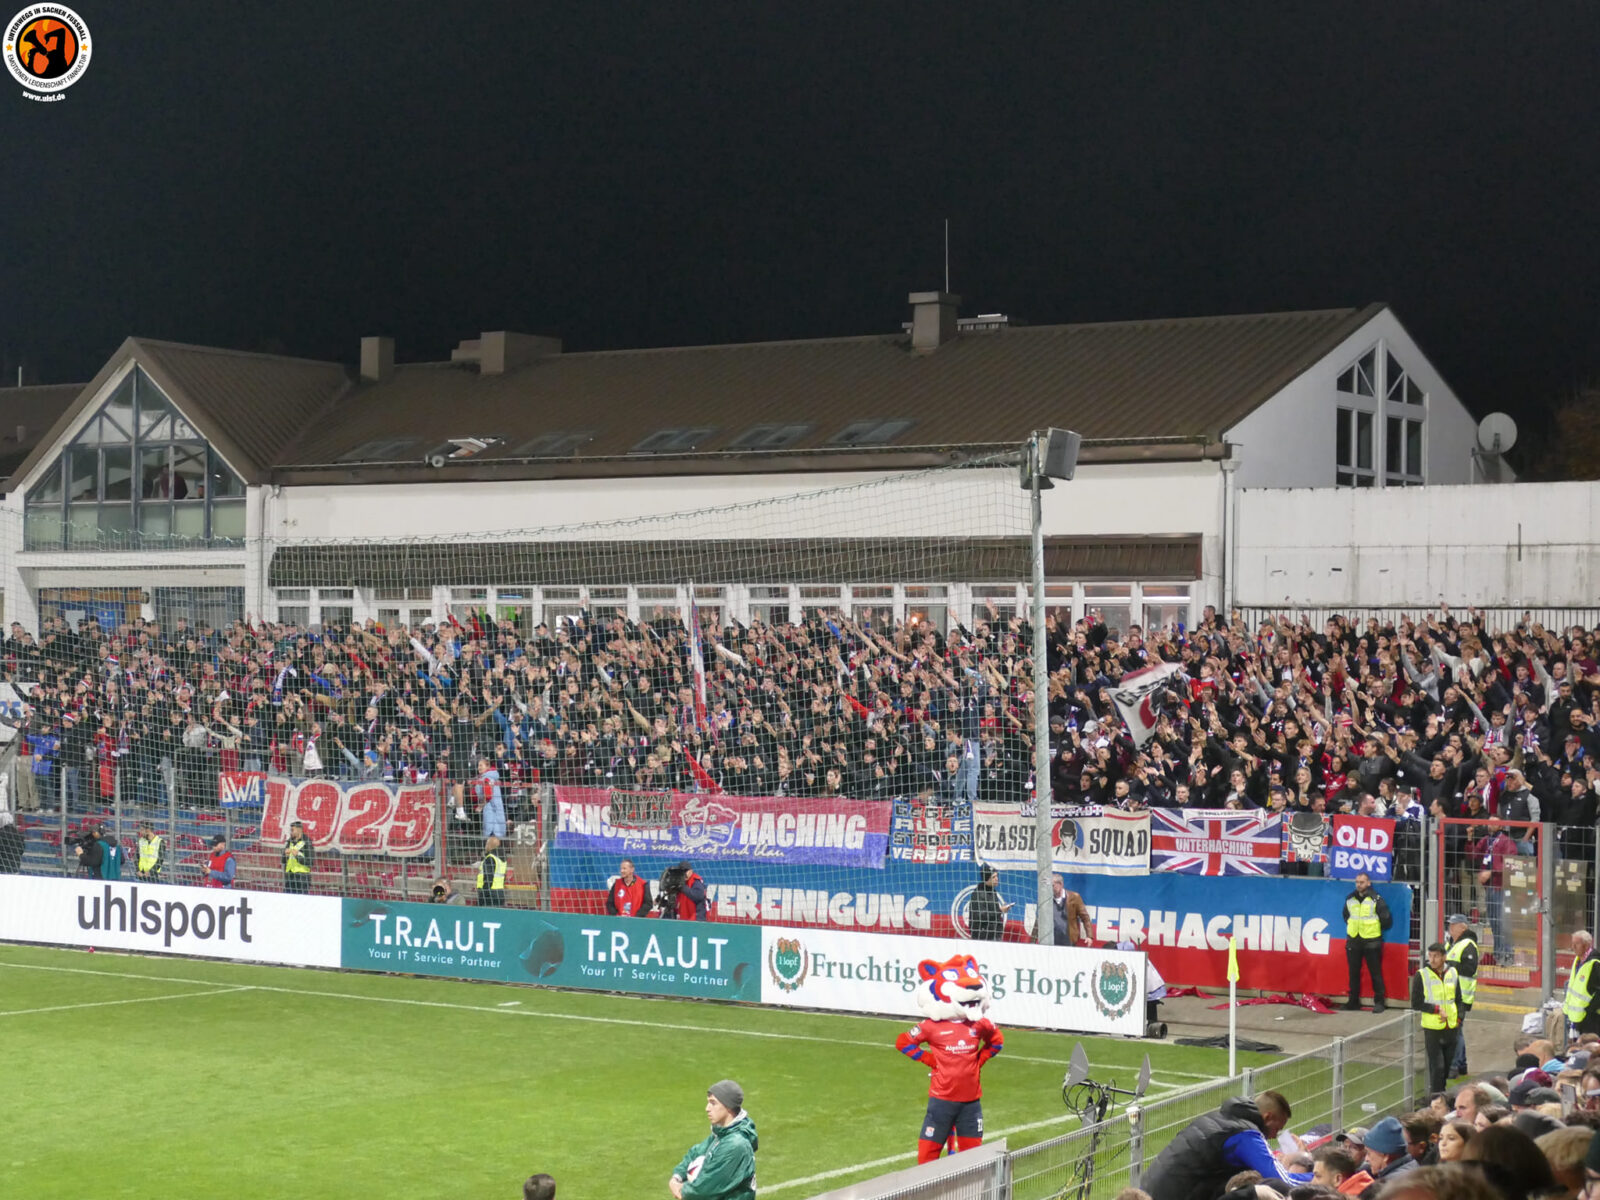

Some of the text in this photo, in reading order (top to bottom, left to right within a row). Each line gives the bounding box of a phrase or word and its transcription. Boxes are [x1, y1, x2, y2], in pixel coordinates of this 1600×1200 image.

[261, 780, 436, 853] 1925
[895, 804, 970, 818] GEGEN
[739, 812, 867, 849] HACHING
[894, 819, 970, 833] ALLE
[1336, 825, 1389, 851] OLD
[623, 836, 647, 850] Für
[720, 845, 749, 857] und
[753, 841, 785, 859] blau
[893, 832, 970, 846] STADION
[975, 823, 1148, 857] CLASSI SQUAD
[1175, 838, 1254, 856] UNTERHACHING
[892, 847, 971, 861] VERBOTE
[1334, 850, 1388, 874] BOYS
[77, 885, 252, 946] uhlsport
[369, 914, 501, 953] T.R.A.U.T
[368, 947, 501, 968] Your IT Service Partner
[581, 929, 728, 971] T.R.A.U.T
[580, 965, 728, 986] Your IT Service Partner
[1014, 967, 1088, 1005] Hopf.
